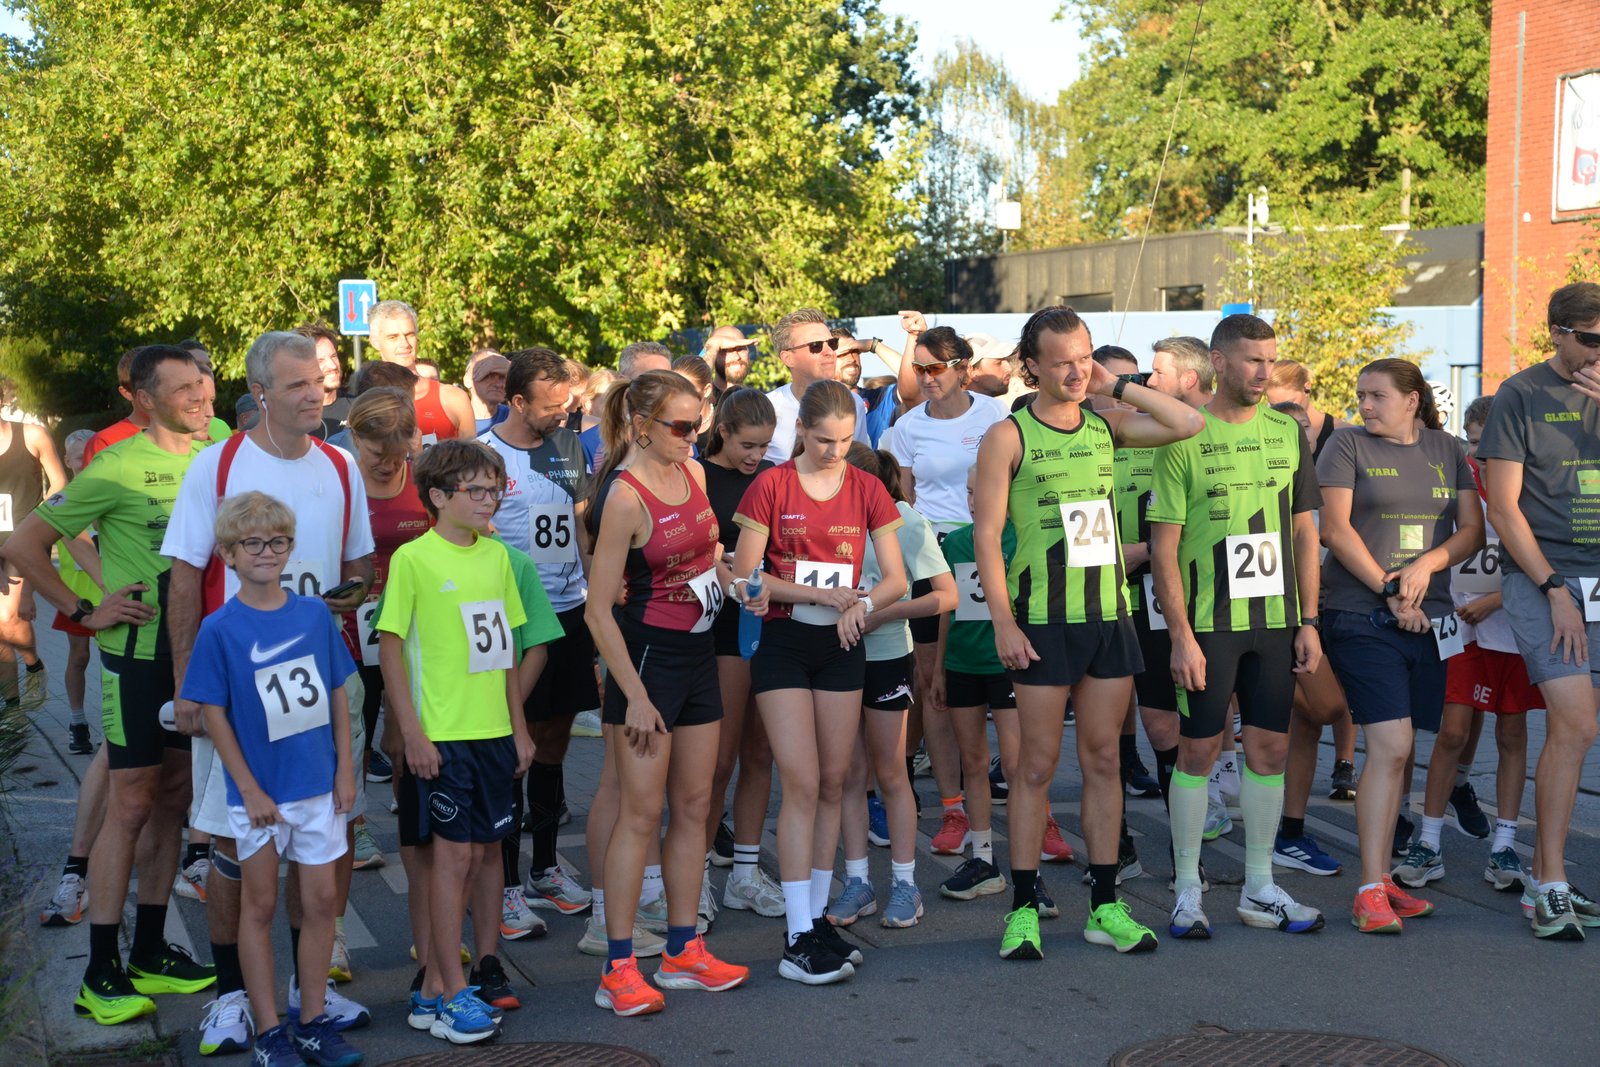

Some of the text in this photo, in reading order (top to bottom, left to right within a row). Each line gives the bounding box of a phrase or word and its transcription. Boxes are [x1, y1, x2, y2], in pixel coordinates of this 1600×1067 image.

[1069, 450, 1094, 459] Athlex
[1236, 444, 1262, 454] Athlex
[1366, 467, 1399, 477] TARA
[534, 514, 571, 549] 85
[1069, 507, 1112, 546] 24
[1234, 540, 1277, 579] 20
[704, 580, 725, 622] 49
[472, 612, 508, 654] 51
[265, 666, 320, 714] 13
